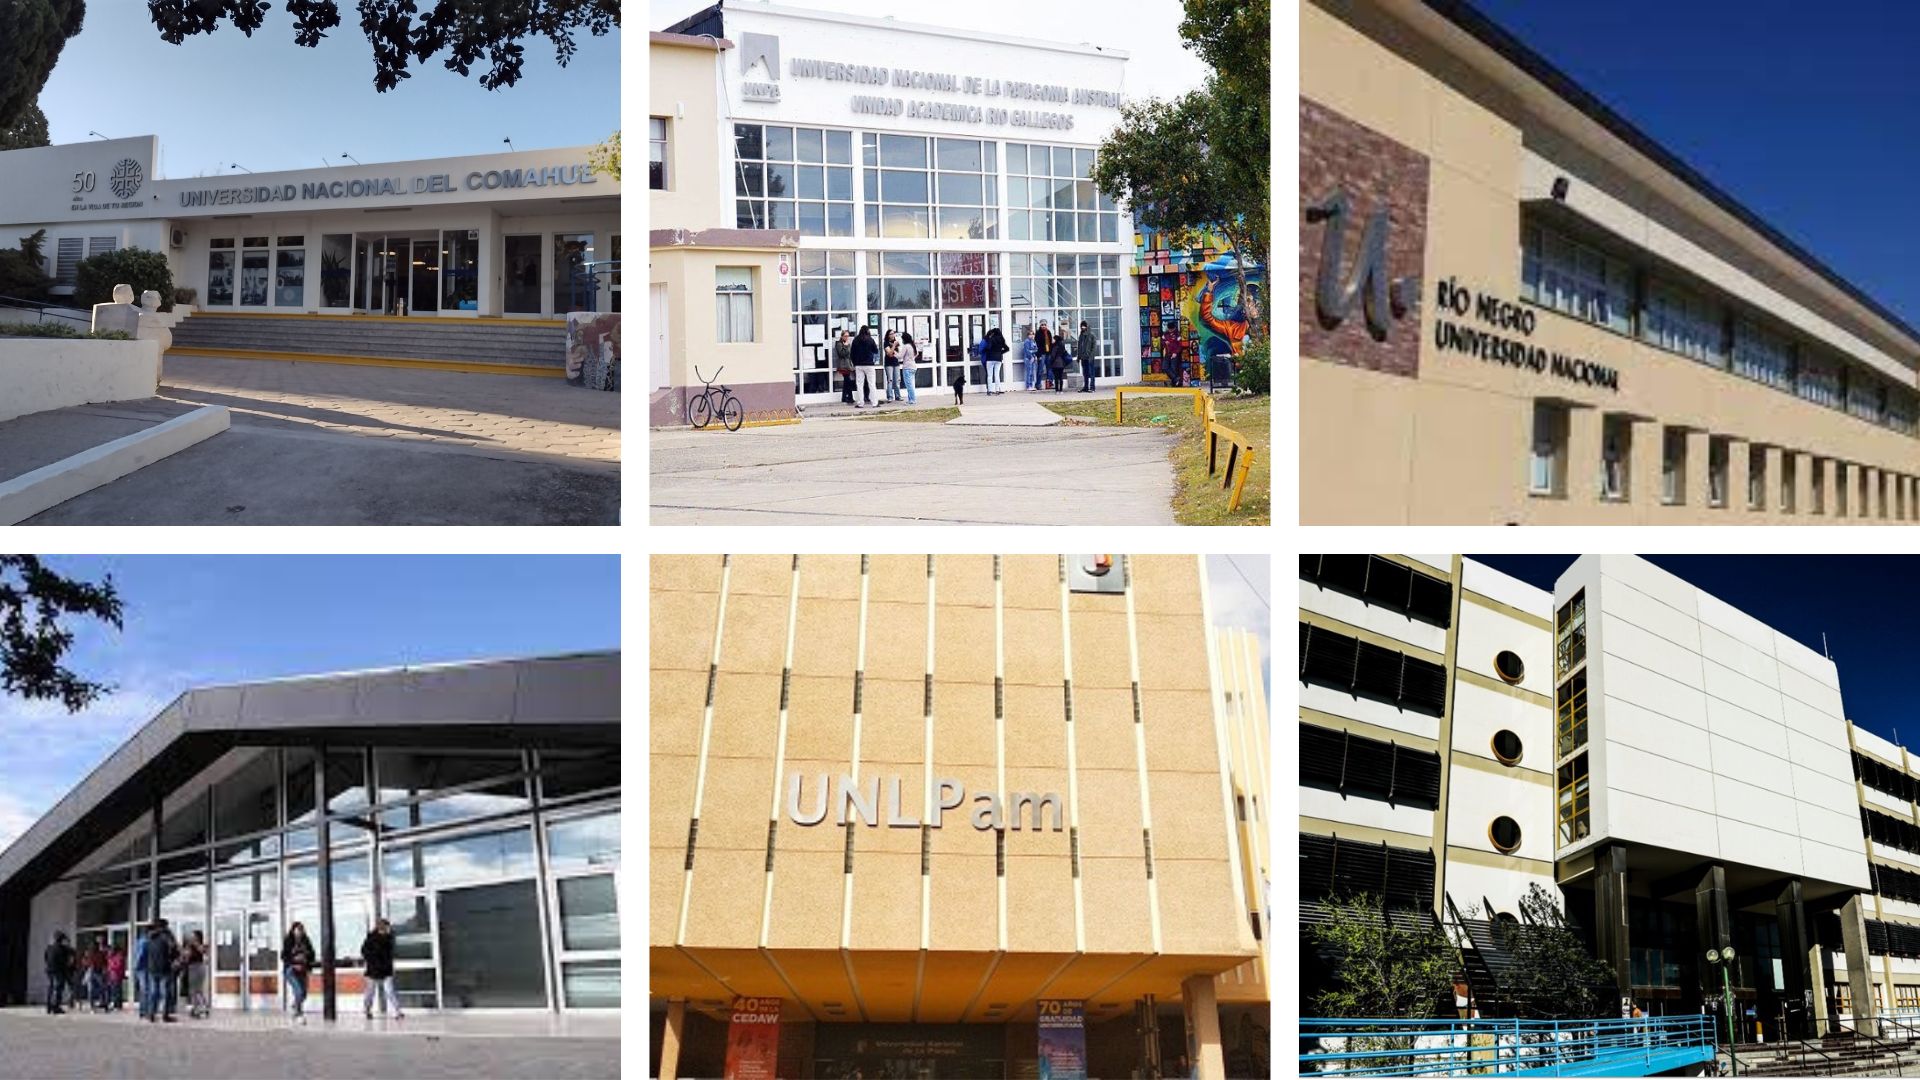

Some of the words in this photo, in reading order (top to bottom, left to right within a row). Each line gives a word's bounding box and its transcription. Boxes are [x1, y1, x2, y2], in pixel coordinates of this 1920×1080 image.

[742, 82, 781, 98] UNPA
[790, 57, 889, 86] UNIVERSIDAD
[892, 68, 960, 92] NACIONAL
[963, 75, 982, 95] DE
[984, 79, 1000, 97] LA
[1003, 81, 1068, 103] PATAGONIA
[851, 95, 905, 117] UNIDAD
[907, 100, 983, 124] ACADEMICA
[985, 107, 1008, 126] RIO
[1010, 109, 1075, 131] GALLEGOS
[72, 170, 96, 194] 50
[179, 184, 297, 208] UNIVERSIDAD
[302, 177, 408, 201] NACIONAL
[412, 174, 458, 194] DEL
[466, 163, 598, 191] COMAHUE
[1437, 276, 1470, 317] RÍO
[1476, 293, 1535, 337] NEGRO
[1435, 319, 1548, 375] UNIVERSIDAD
[1551, 351, 1620, 393] NACIONAL
[787, 773, 1063, 832] UNLPam
[733, 1013, 779, 1024] CEDAW
[734, 998, 759, 1012] 40
[1039, 1000, 1061, 1015] 70
